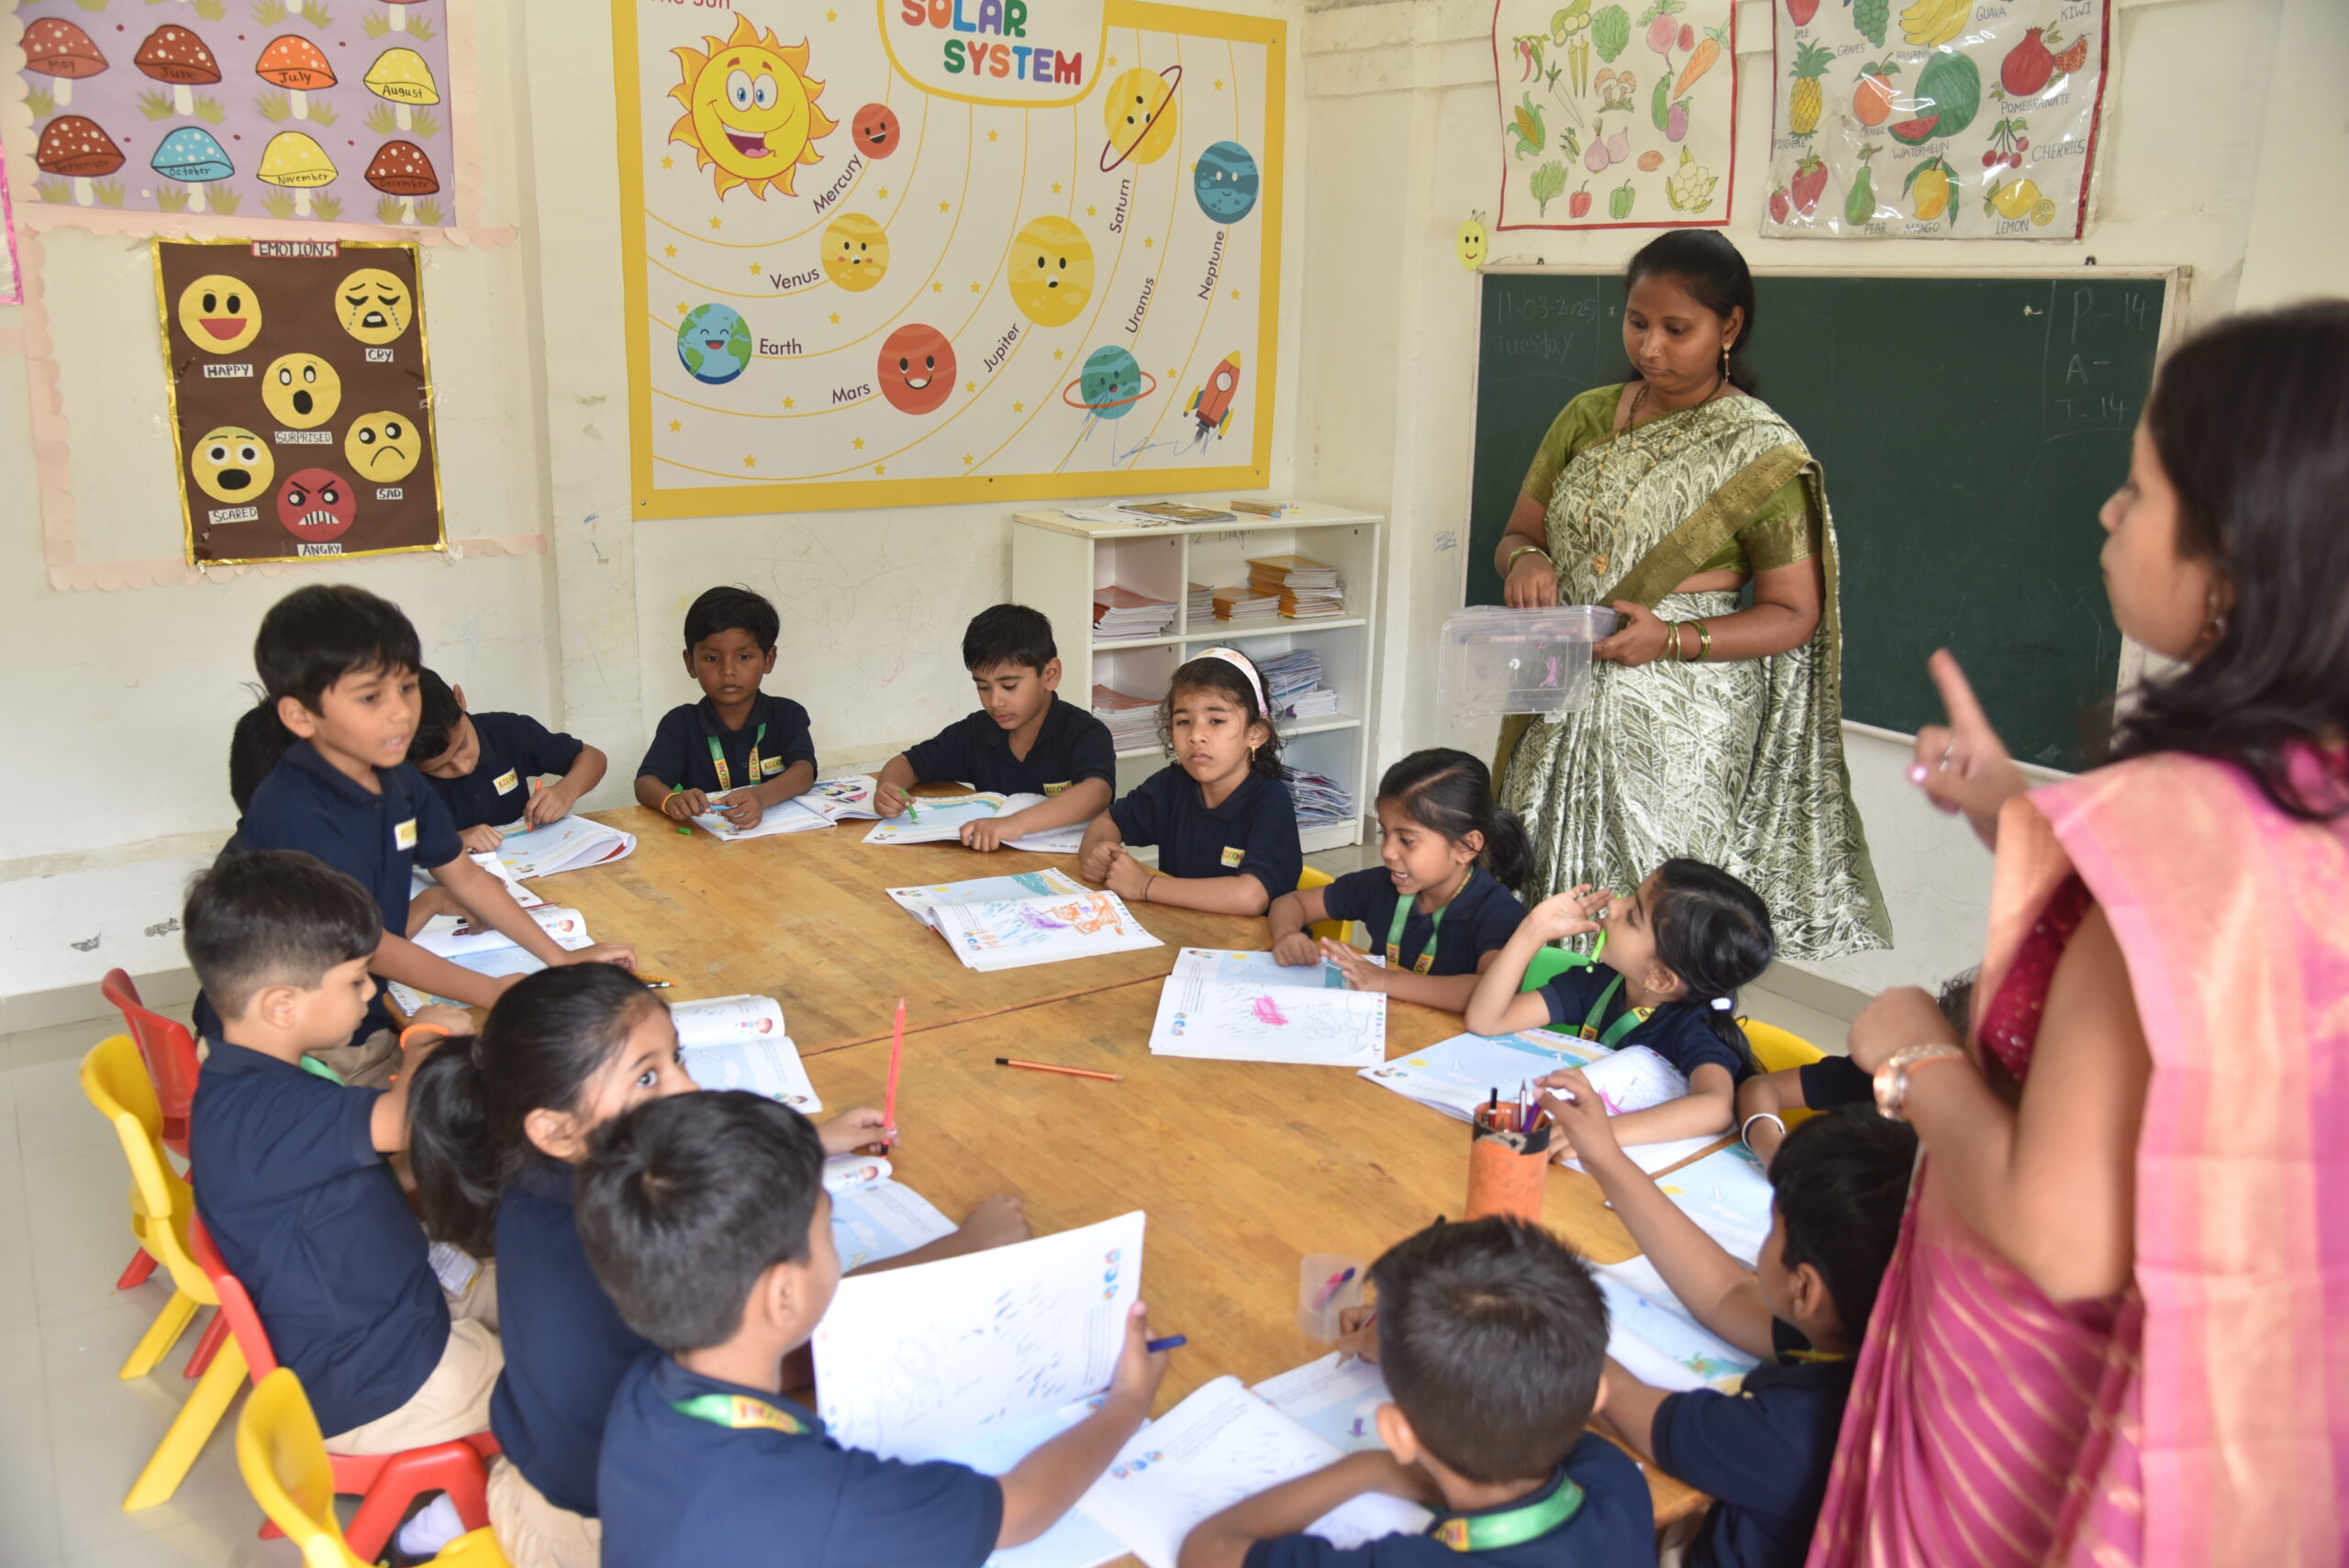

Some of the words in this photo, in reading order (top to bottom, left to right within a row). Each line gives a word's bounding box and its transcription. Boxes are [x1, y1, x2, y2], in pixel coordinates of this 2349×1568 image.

[901, 0, 1027, 38] SOLAR
[1976, 6, 2007, 21] GUAVA
[2061, 2, 2091, 21] KIWI
[1837, 44, 1865, 57] GRAPES
[48, 59, 75, 72] May
[943, 39, 1082, 85] SYSTEM
[161, 66, 198, 80] June
[278, 72, 312, 85] July
[382, 84, 423, 99] August
[2001, 93, 2070, 116] POMEGRANATE
[1893, 141, 1949, 160] WATERMELON
[2032, 139, 2086, 161] CHERRIES
[169, 165, 211, 177] October
[277, 173, 329, 184] November
[812, 153, 863, 215] Mercury
[1108, 179, 1130, 234] Saturn
[1865, 223, 1887, 235] PEAR
[1996, 220, 2030, 235] LEMON
[259, 242, 333, 257] EMOTIONS
[1197, 230, 1225, 301] Neptune
[770, 268, 820, 290] Venus
[1125, 276, 1154, 334] Uranus
[759, 338, 803, 356] Earth
[984, 323, 1020, 374] Jupiter
[1491, 330, 1574, 369] Tuesday
[368, 350, 392, 361] CRY
[207, 364, 250, 377] HAPPY
[832, 382, 871, 405] Mars
[276, 431, 331, 444] SURPRISED
[378, 488, 402, 499] SAD
[213, 507, 258, 521] SCARED
[302, 544, 340, 556] ANGRY
